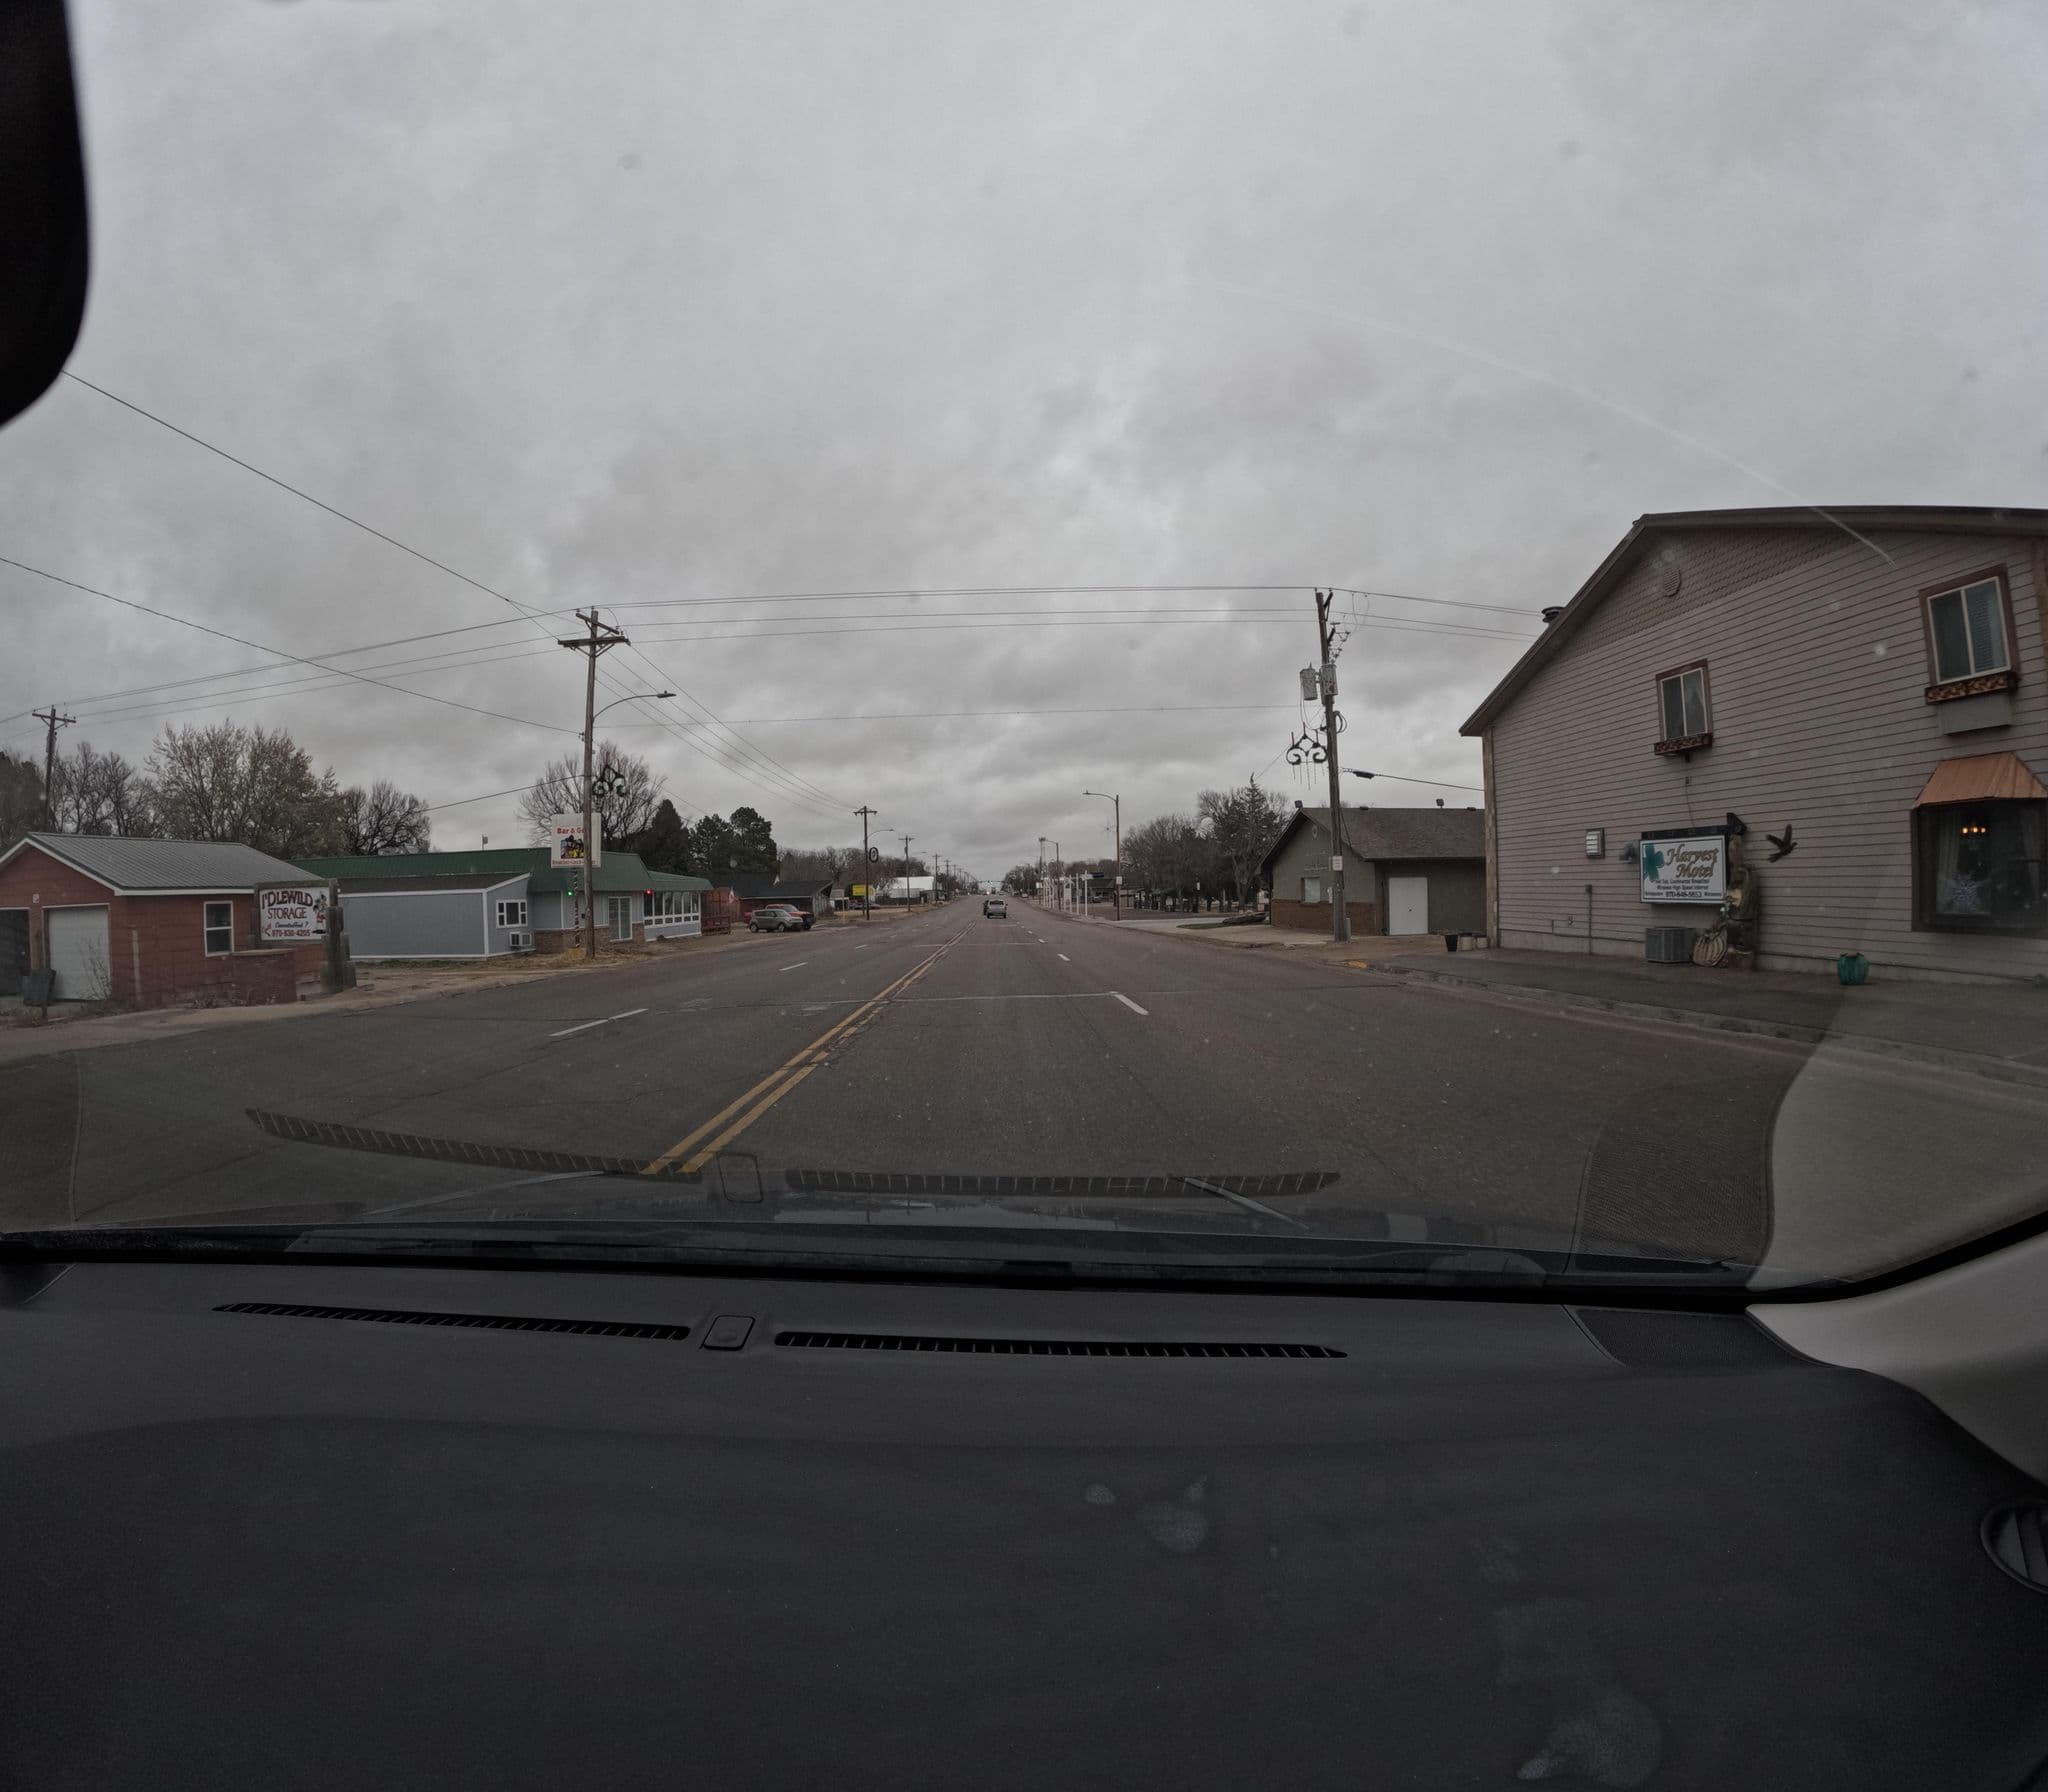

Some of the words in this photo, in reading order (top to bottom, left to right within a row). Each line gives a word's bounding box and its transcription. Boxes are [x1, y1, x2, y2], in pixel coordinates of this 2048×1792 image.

[1665, 843, 1719, 866] Harvest
[1676, 862, 1713, 878] Motel
[267, 907, 308, 920] STORAGE
